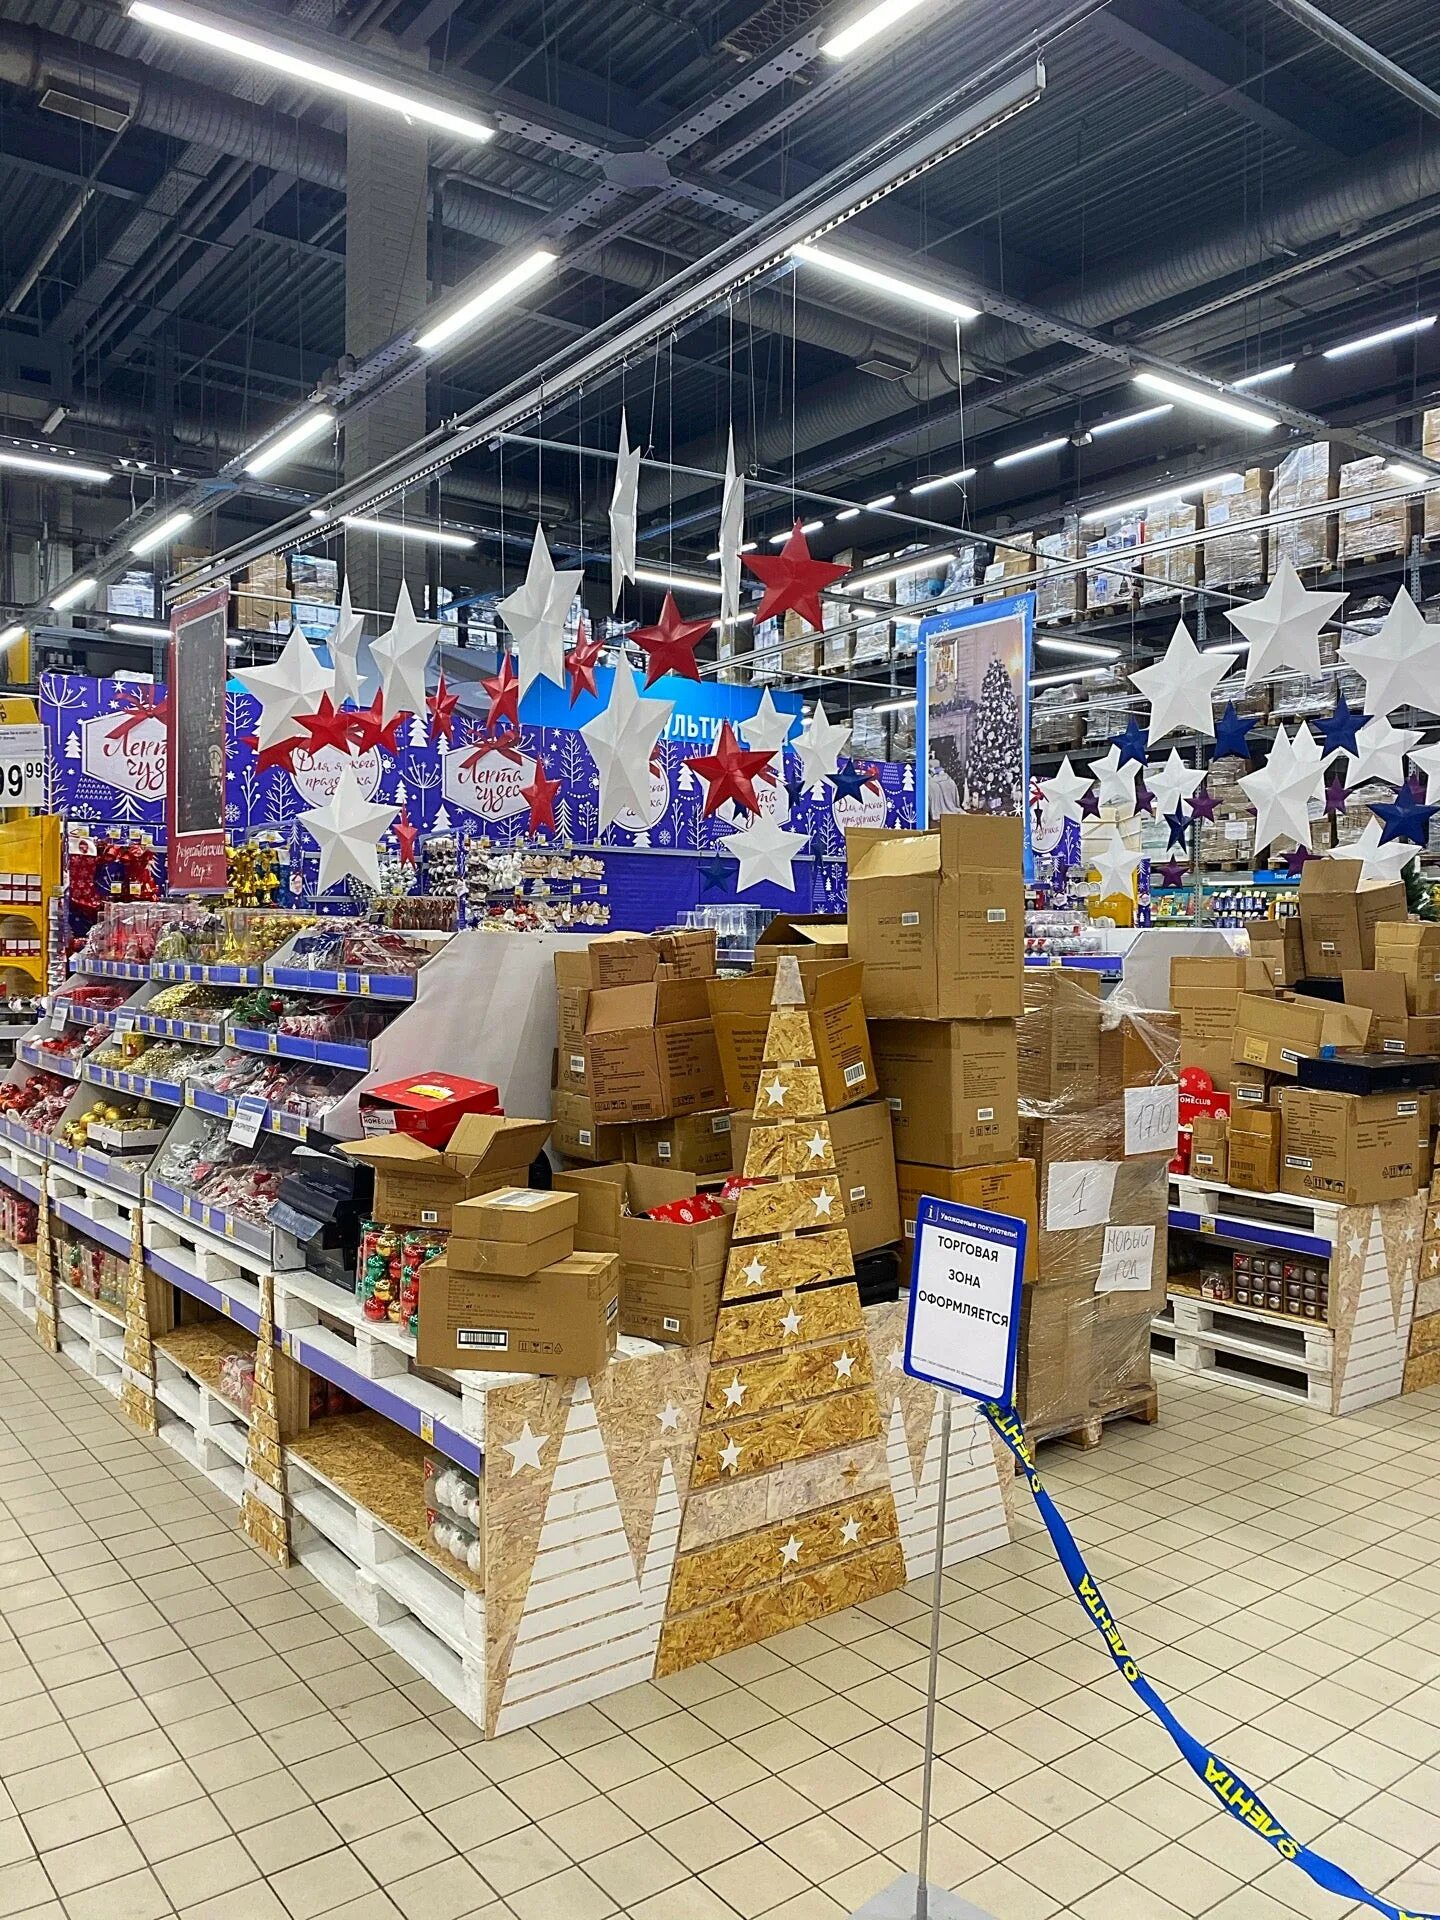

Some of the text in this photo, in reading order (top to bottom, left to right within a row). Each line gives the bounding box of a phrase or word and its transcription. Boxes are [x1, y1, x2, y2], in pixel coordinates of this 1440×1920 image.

[0, 762, 43, 797] 9 99
[335, 760, 375, 772] якого
[458, 762, 524, 784] Лента
[475, 785, 520, 813] чудес
[1180, 1096, 1212, 1106] OMECLUB
[1072, 1175, 1087, 1216] 1
[940, 1212, 1018, 1239] Уважаемые покупатели!
[937, 1235, 999, 1262] ТОРГОВАЯ
[948, 1268, 981, 1289] ЗОНА
[918, 1290, 1009, 1327] ОФОРМЛЯЕТСЯ
[1079, 1573, 1128, 1656] ЛЕНТА
[1204, 1757, 1285, 1838] ЛЕНТА
